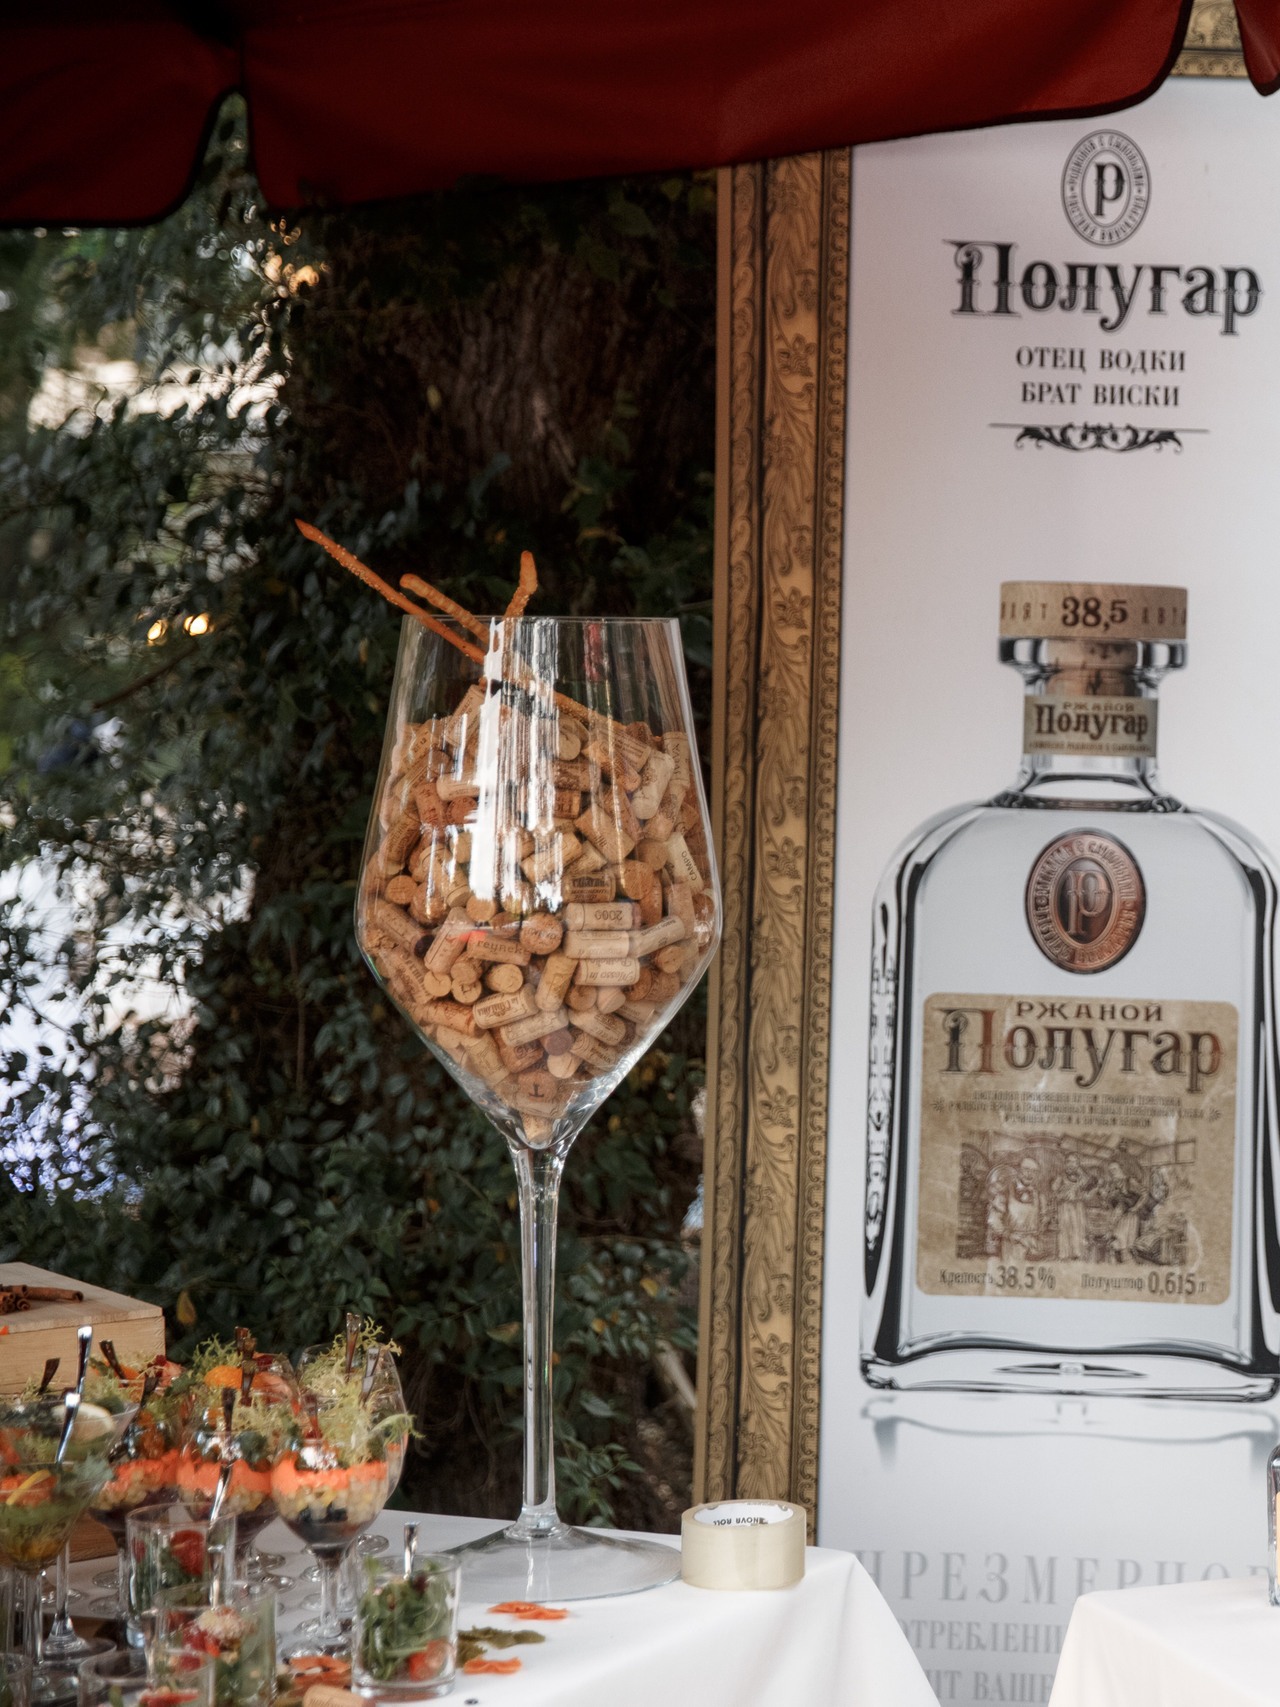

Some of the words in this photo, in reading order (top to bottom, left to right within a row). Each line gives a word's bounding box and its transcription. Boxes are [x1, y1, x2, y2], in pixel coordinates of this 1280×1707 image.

[942, 239, 1263, 335] Полугар
[1016, 347, 1087, 374] ОТЕЦ
[1099, 349, 1186, 374] ВОДКИ
[1021, 382, 1082, 405] БРАТ
[1093, 384, 1181, 407] ВИСКИ
[1062, 596, 1128, 633] 38,5
[1034, 704, 1148, 741] Полугар
[681, 850, 697, 881] CAMPO
[1016, 1001, 1163, 1022] РЖАНОЙ
[934, 1006, 1223, 1093] Полугар
[1148, 1271, 1196, 1297] 0,615
